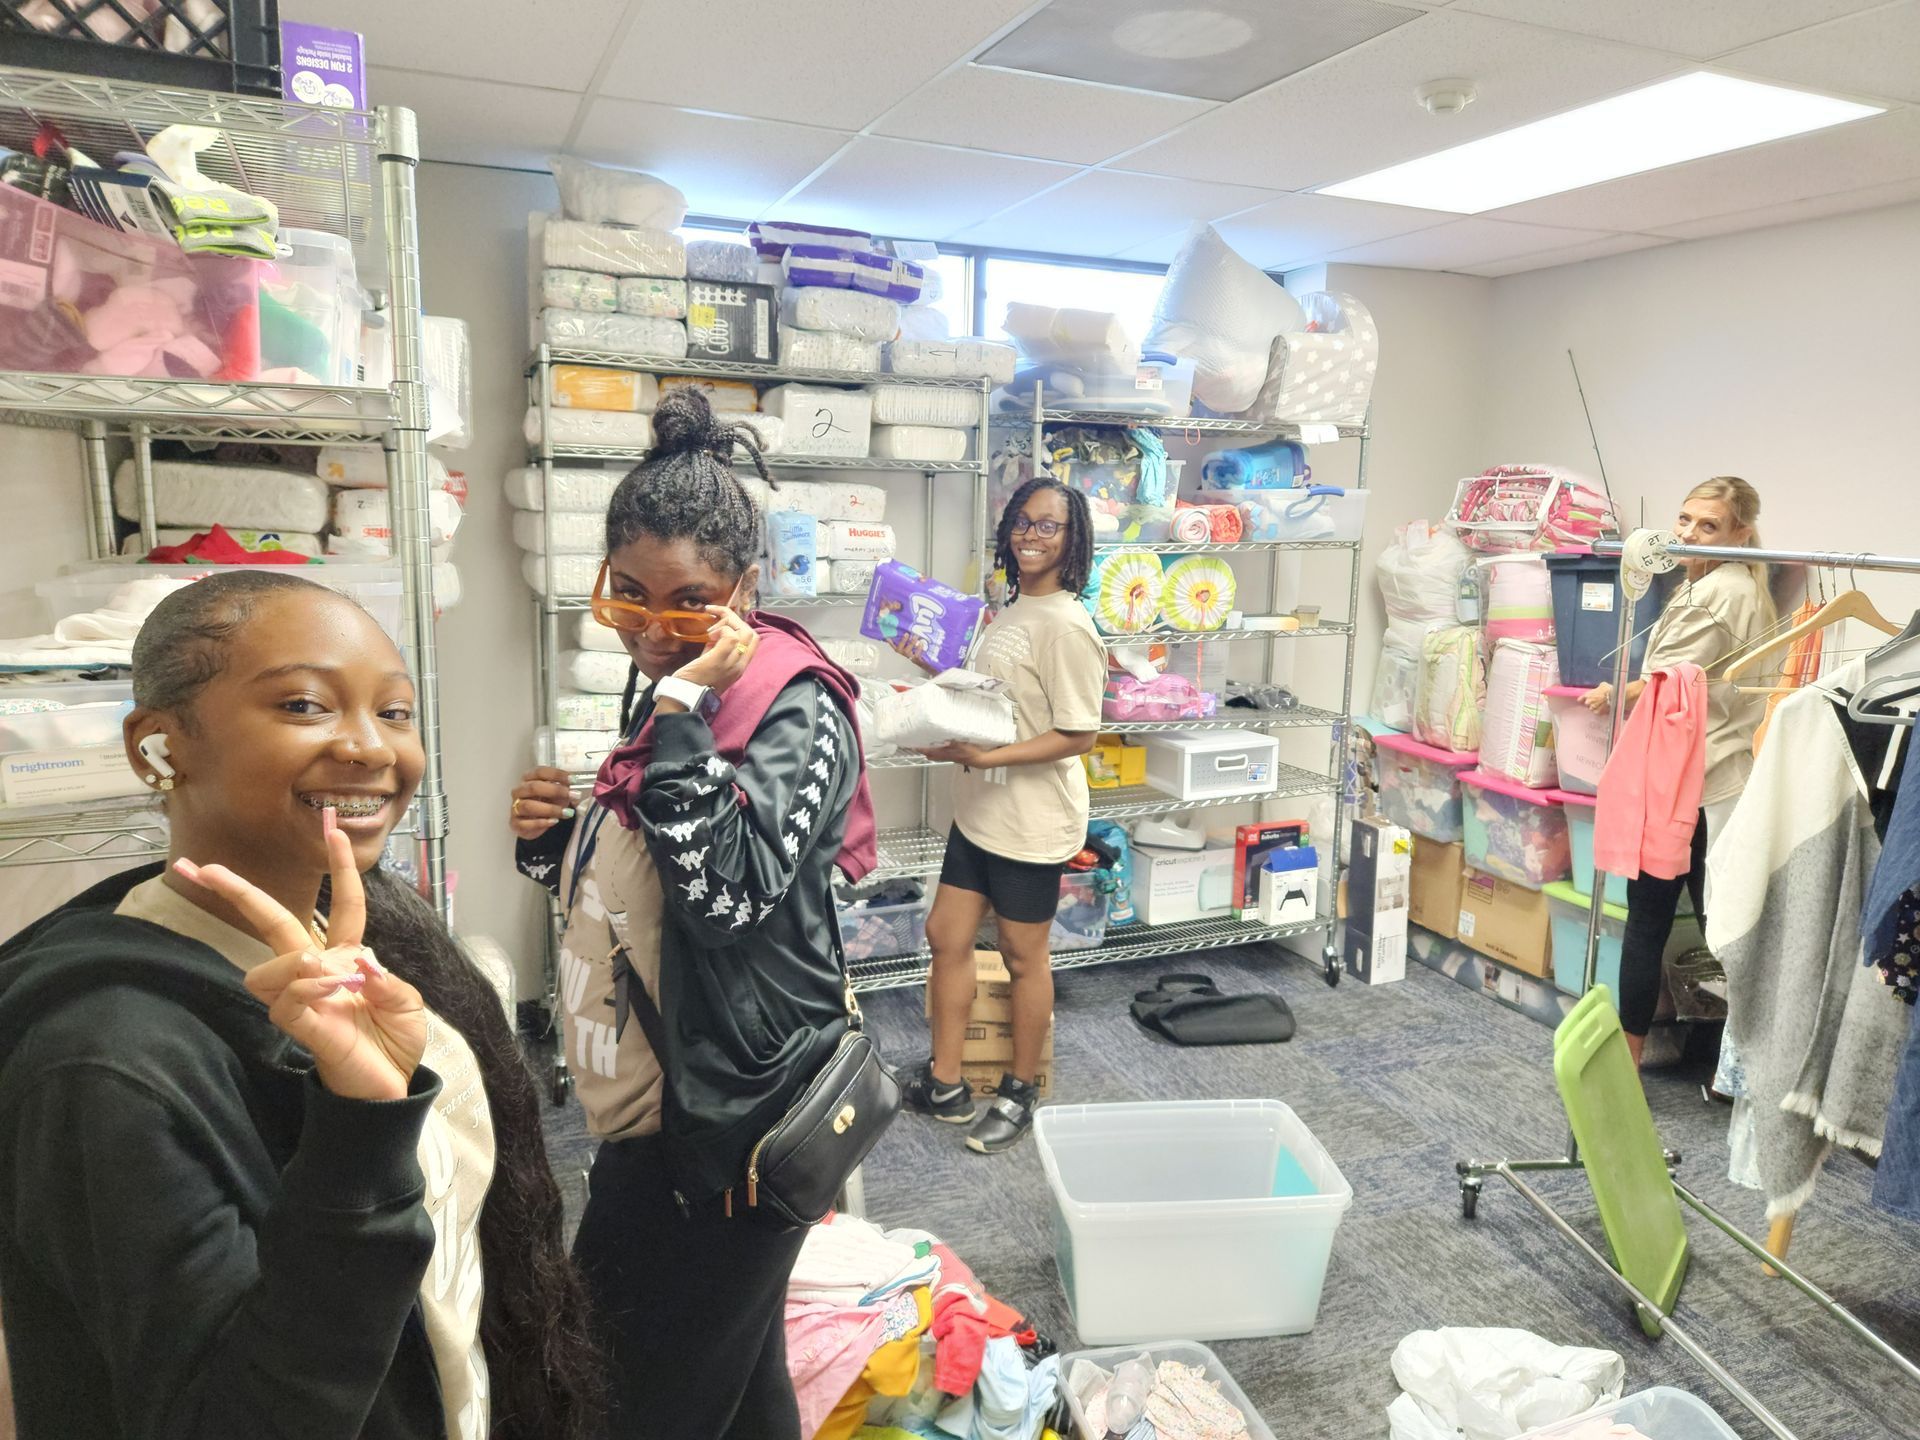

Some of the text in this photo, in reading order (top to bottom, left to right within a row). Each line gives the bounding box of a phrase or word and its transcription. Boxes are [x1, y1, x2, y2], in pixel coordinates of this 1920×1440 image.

[296, 55, 329, 70] DESIGNS
[330, 60, 346, 73] FUN
[812, 408, 850, 438] 2
[850, 495, 864, 507] 2
[849, 528, 886, 538] HUGGIES
[1647, 535, 1660, 546] 2T
[10, 759, 85, 774] brightroom
[1156, 858, 1177, 866] cricut
